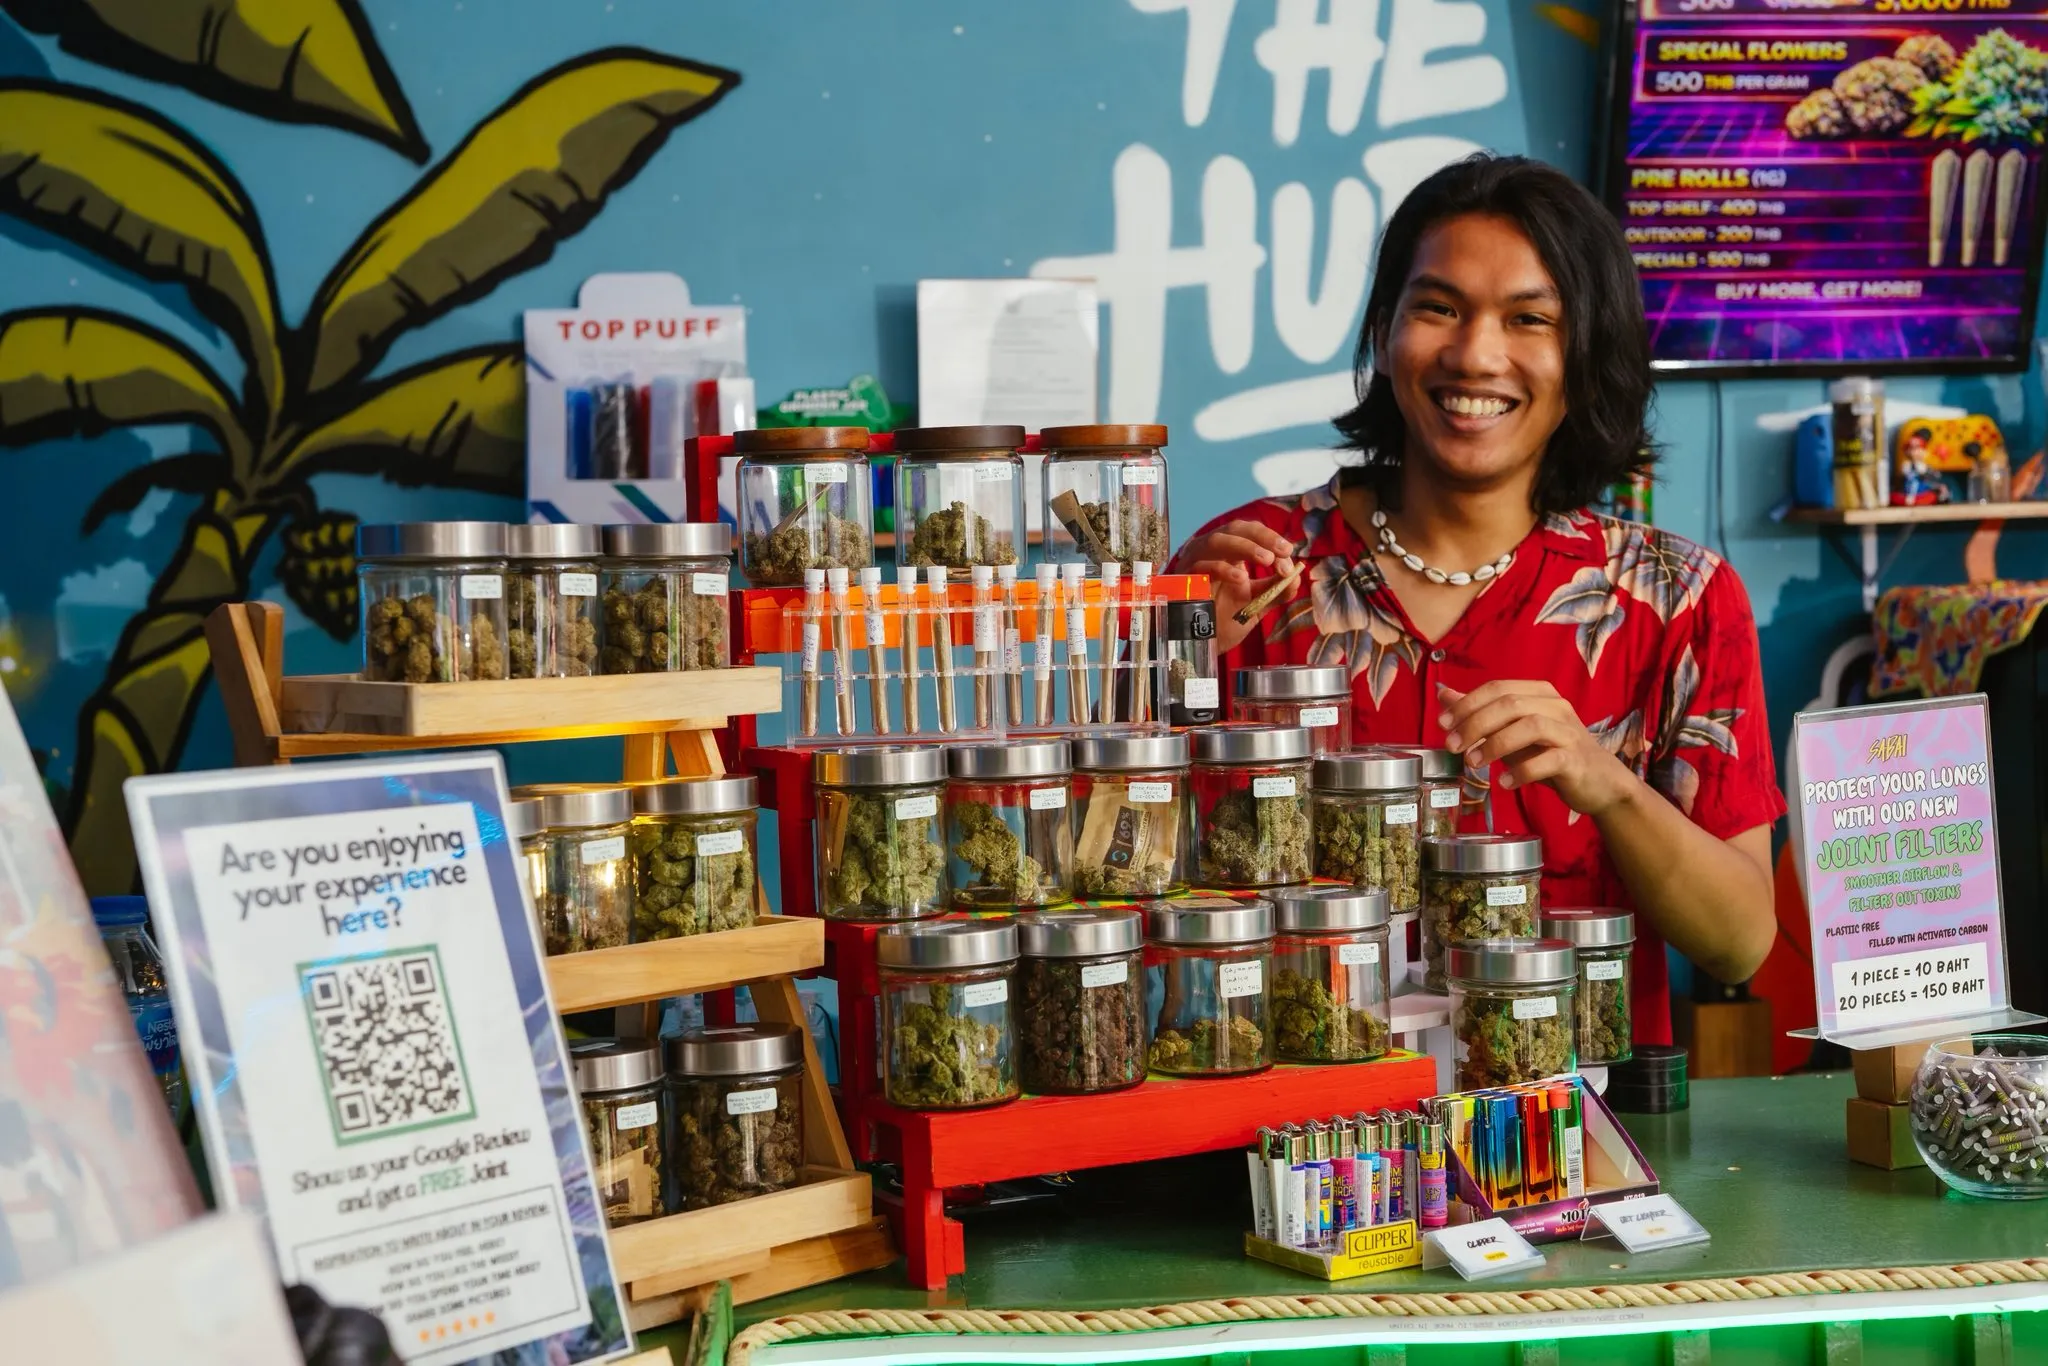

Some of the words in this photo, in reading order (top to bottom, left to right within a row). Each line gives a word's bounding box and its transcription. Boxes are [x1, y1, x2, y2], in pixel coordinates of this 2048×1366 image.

[1658, 41, 1745, 61] SPECIAL
[1747, 41, 1848, 61] FLOWERS
[1126, 0, 1508, 148] THE
[1656, 71, 1703, 92] 500
[1704, 74, 1735, 90] THB
[1736, 74, 1764, 90] PER
[1631, 168, 1676, 188] PRE
[1679, 168, 1749, 188] ROLLS
[1627, 200, 1661, 215] TOP
[1663, 200, 1713, 215] SHELF
[1720, 199, 1757, 215] 400
[1633, 252, 1697, 268] PECIALS
[1715, 283, 1756, 299] BUY
[1822, 282, 1859, 298] GET
[1861, 281, 1922, 298] MORE!
[557, 320, 625, 342] TOP
[633, 317, 721, 339] PUFF
[1804, 775, 1876, 805] PROTECT
[1879, 769, 1926, 796] YOUR
[1929, 762, 1987, 790] LUNGS
[1832, 806, 1875, 830] WITH
[1880, 800, 1917, 824] OUR
[1921, 795, 1958, 818] NEW
[218, 841, 277, 877] Are
[283, 843, 340, 877] you
[348, 823, 466, 868] enjoying
[1816, 831, 1891, 870] JOINT
[1895, 820, 1983, 860] FILTERS
[234, 881, 305, 921] your
[315, 861, 467, 905] experience
[1844, 870, 1900, 891] SMOOTHER
[1902, 865, 1949, 886] AIRFLOW
[1952, 863, 1962, 877] &
[1848, 895, 1893, 913] FILTERS
[1896, 891, 1920, 908] OUT
[1921, 885, 1961, 904] TOXINS
[319, 896, 403, 937] here?
[1861, 921, 1880, 933] FREE
[1868, 935, 1895, 948] FILLED
[1897, 932, 1915, 945] WITH
[1917, 928, 1957, 943] ACTIVATED
[1958, 923, 1988, 938] CARBON
[1850, 971, 1858, 987] 1
[1862, 967, 1899, 986] PIECE
[1915, 960, 1932, 977] 10
[1937, 957, 1970, 973] BAHT
[1839, 995, 1857, 1011] 20
[1862, 989, 1906, 1009] PIECES
[1922, 983, 1947, 1000] 150
[1952, 978, 1985, 995] BAHT
[148, 1018, 176, 1034] Nest
[292, 1172, 344, 1194] Show
[413, 1141, 470, 1166] Google
[474, 1127, 531, 1152] Review
[420, 1167, 466, 1195] FREE
[469, 1160, 510, 1184] Joint
[1354, 1230, 1408, 1252] CLIPPER
[1358, 1253, 1404, 1270] reusable
